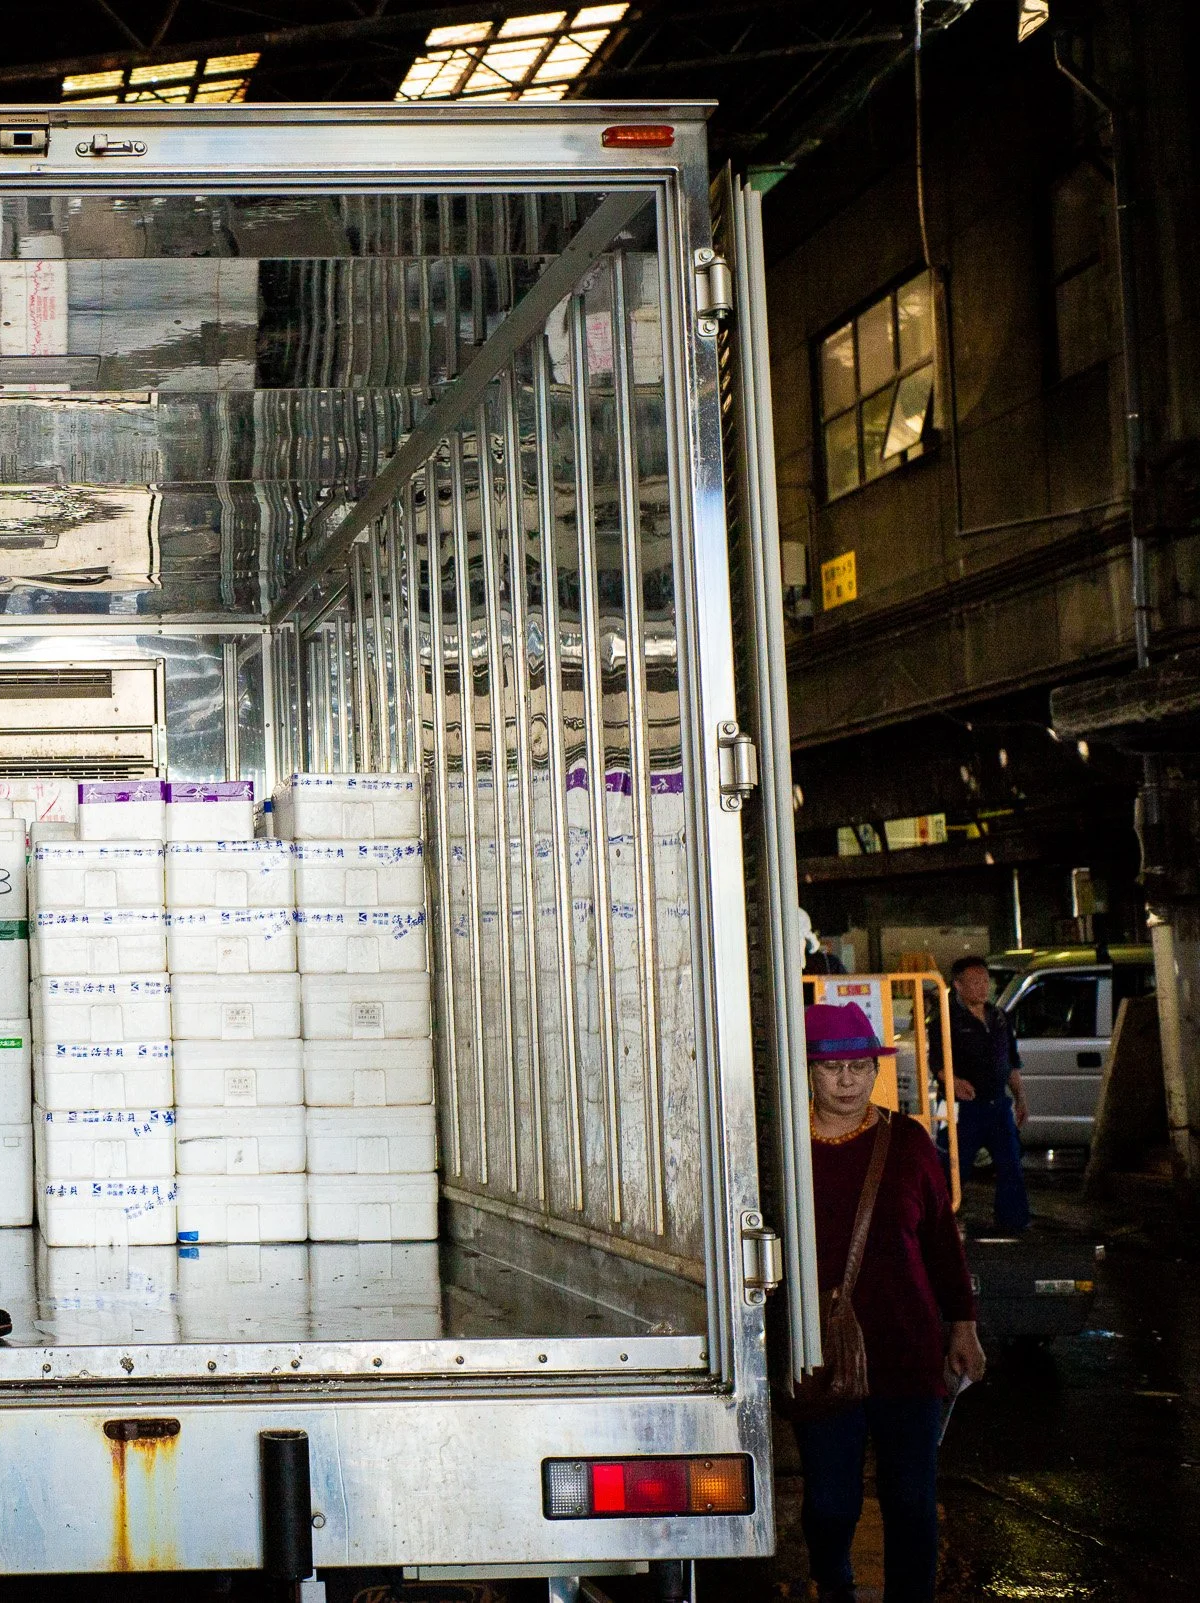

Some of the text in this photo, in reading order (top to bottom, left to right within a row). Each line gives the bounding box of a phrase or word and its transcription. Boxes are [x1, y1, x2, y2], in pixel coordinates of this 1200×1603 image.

[102, 1112, 136, 1122] 活赤貝
[126, 1185, 160, 1196] 活赤貝
